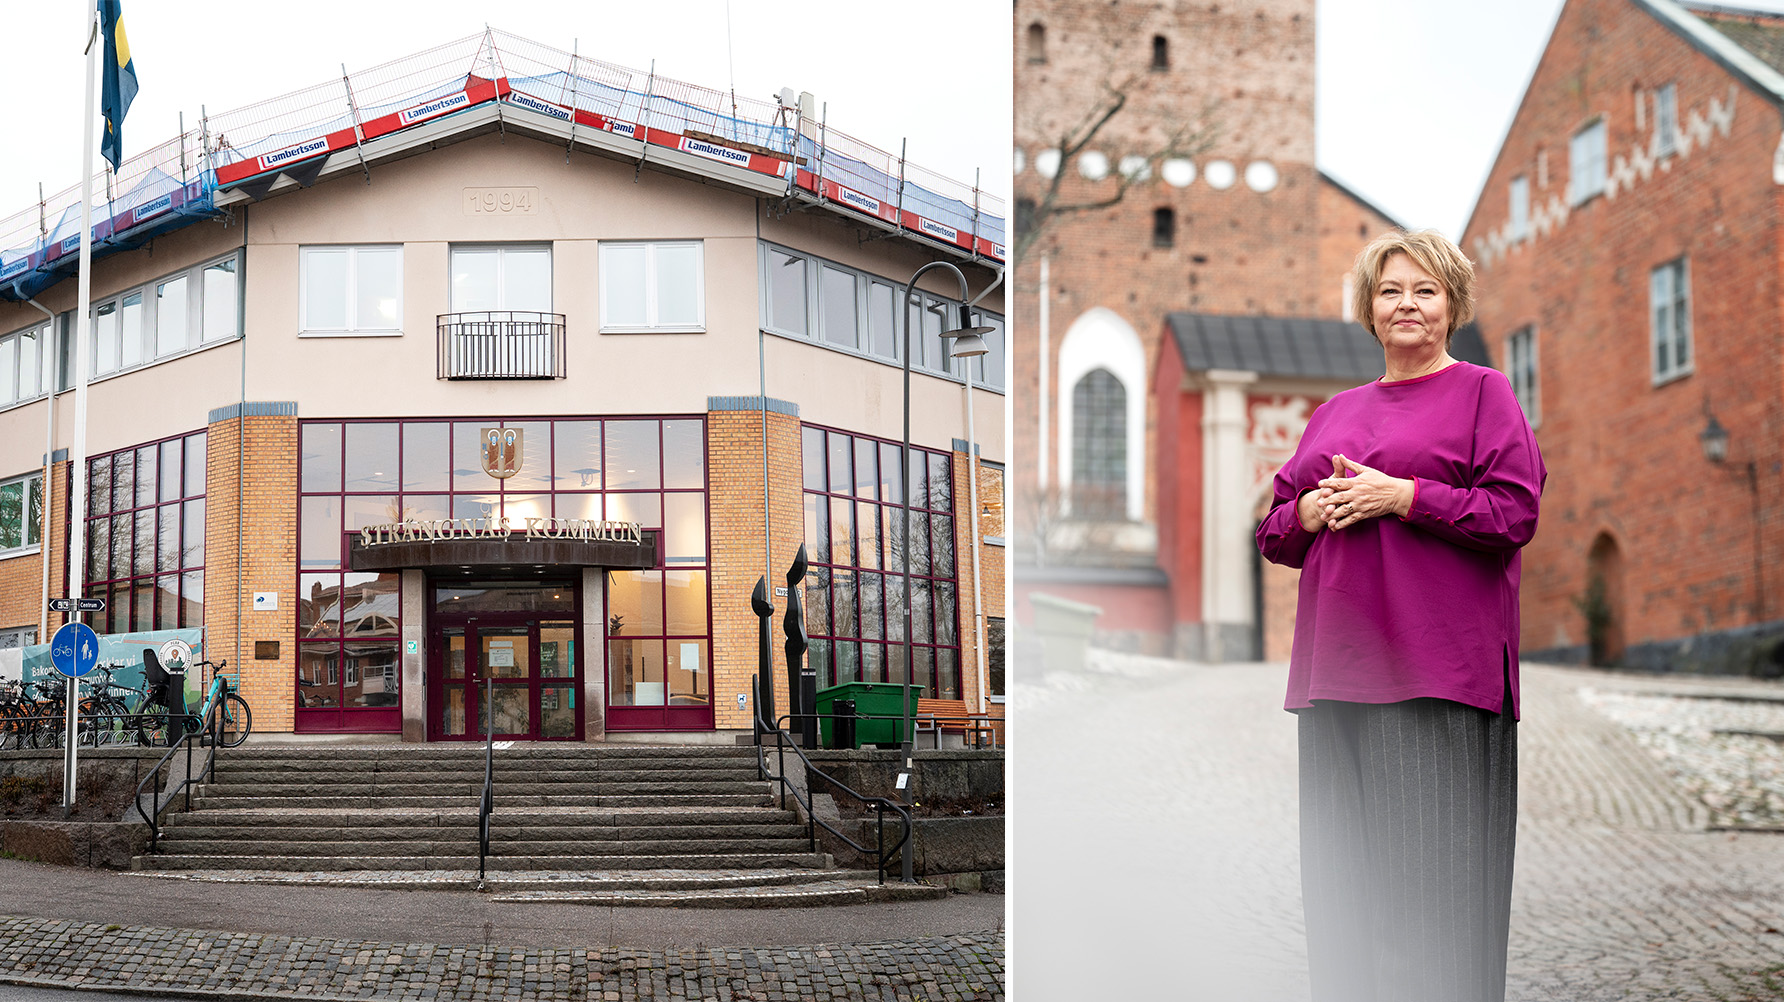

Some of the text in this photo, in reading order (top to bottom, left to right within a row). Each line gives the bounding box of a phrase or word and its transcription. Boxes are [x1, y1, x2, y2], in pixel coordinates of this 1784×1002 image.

[408, 94, 466, 119] Lambertsson
[512, 93, 569, 120] Lambertsson
[267, 140, 326, 164] Lambertsson
[688, 141, 748, 162] Lambertsson
[137, 197, 171, 217] Lambertsson
[470, 190, 531, 212] 1994
[843, 189, 878, 211] Lambertsson
[923, 220, 956, 240] Lambertsson
[360, 513, 643, 547] STRÄNGNÄS KOMMUN
[32, 665, 55, 677] Bakom
[126, 654, 136, 666] vi
